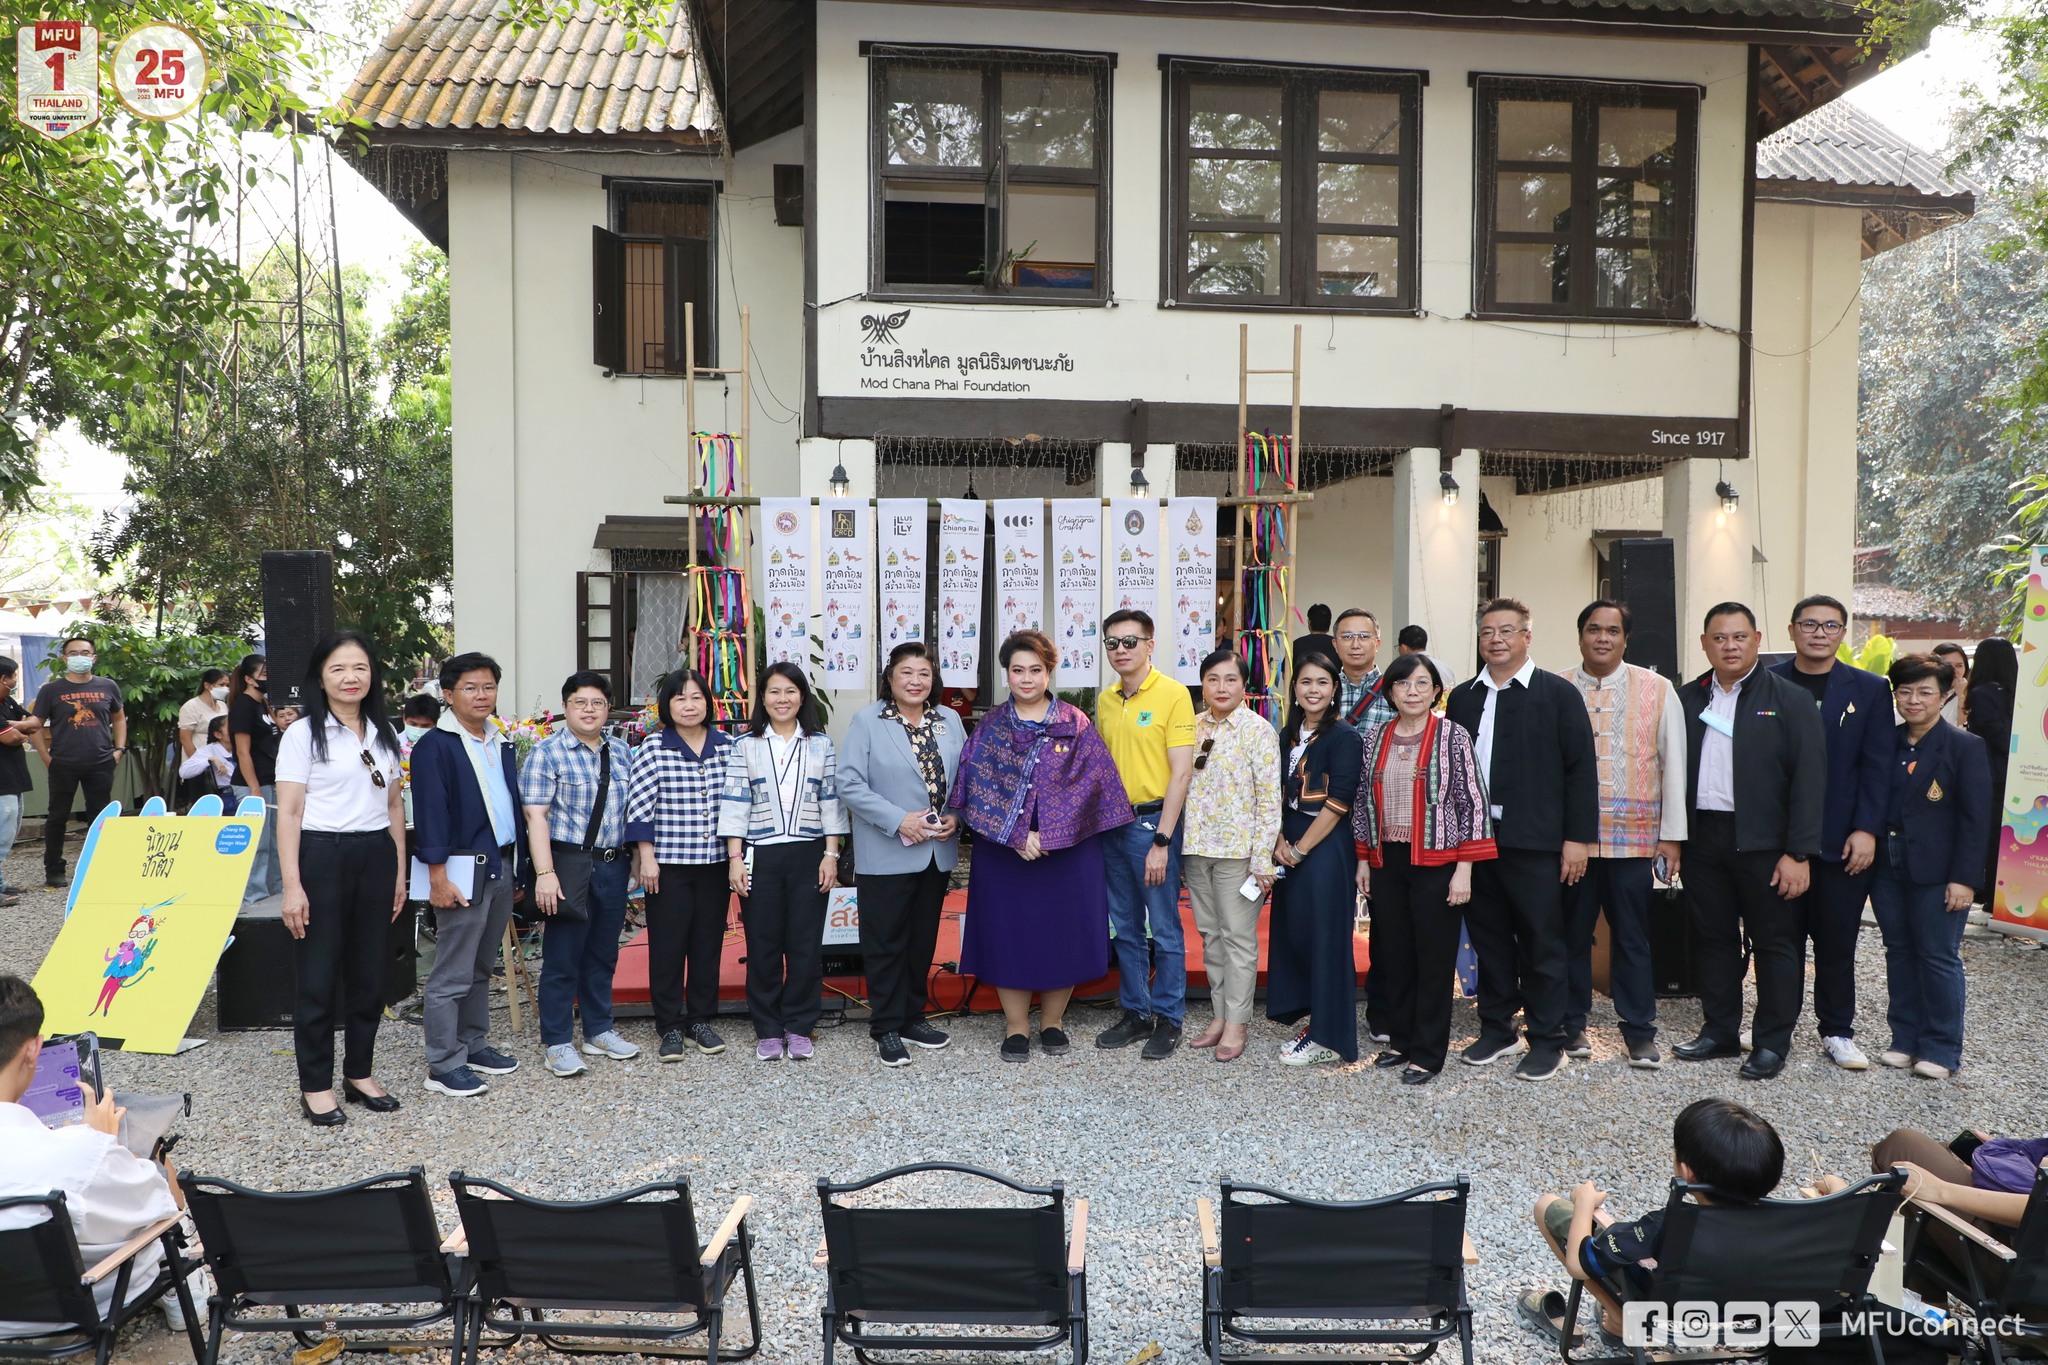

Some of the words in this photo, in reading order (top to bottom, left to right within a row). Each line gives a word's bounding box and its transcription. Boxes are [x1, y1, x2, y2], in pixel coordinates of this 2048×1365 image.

[860, 346, 950, 369] บ้านสิงหไคล
[957, 352, 1075, 376] มูลนิธิมดชนะภัย
[860, 377, 889, 390] Mod
[892, 378, 930, 390] Chana
[934, 379, 959, 391] Phai
[963, 380, 1031, 392] Foundation
[1651, 429, 1690, 445] Since
[1696, 431, 1726, 445] 1917
